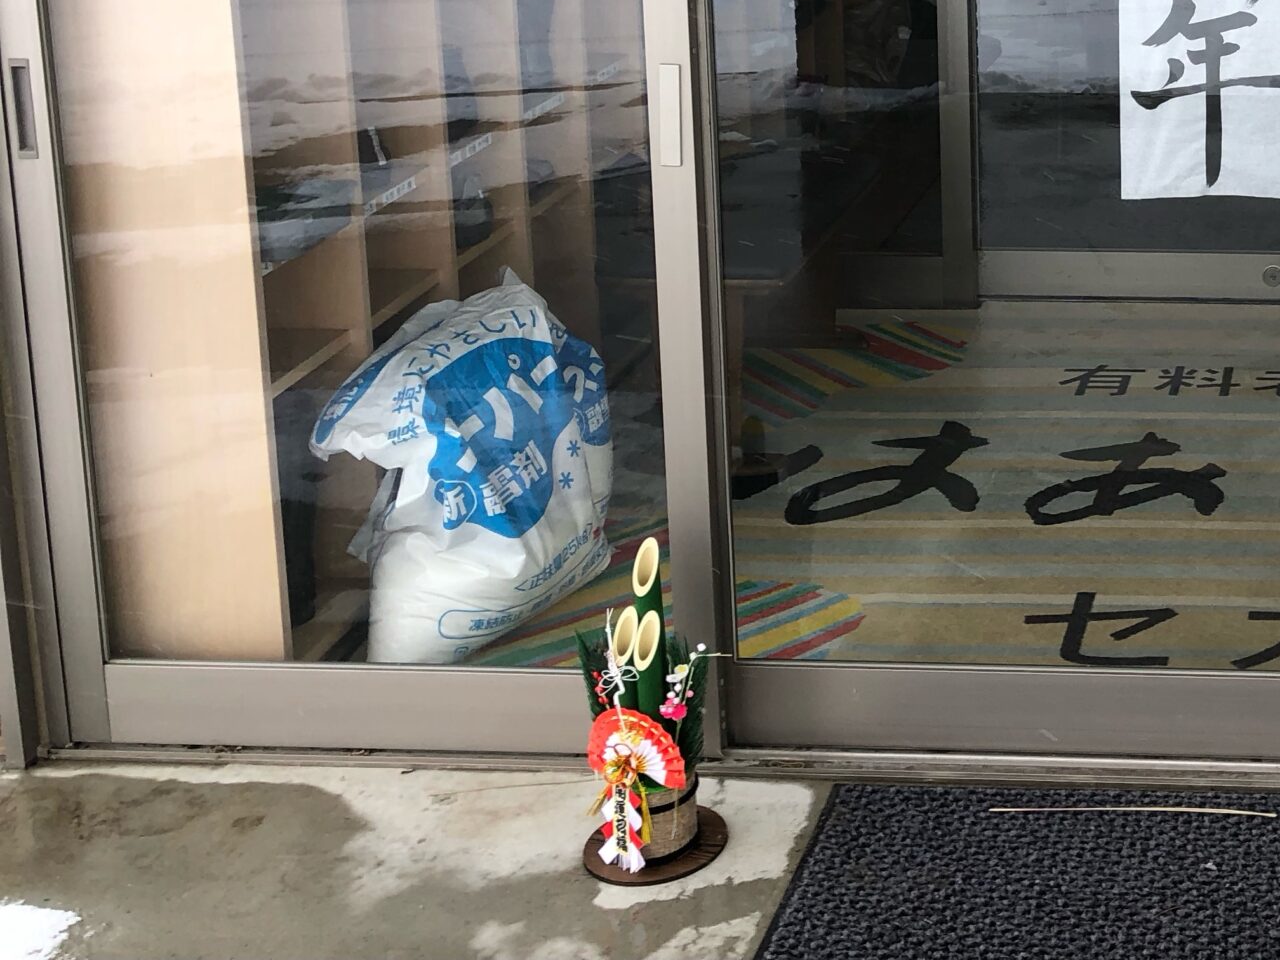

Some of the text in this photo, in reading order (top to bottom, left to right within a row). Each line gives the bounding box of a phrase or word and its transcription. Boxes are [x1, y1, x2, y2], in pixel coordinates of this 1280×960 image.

[387, 307, 537, 446] 環境にやさしい
